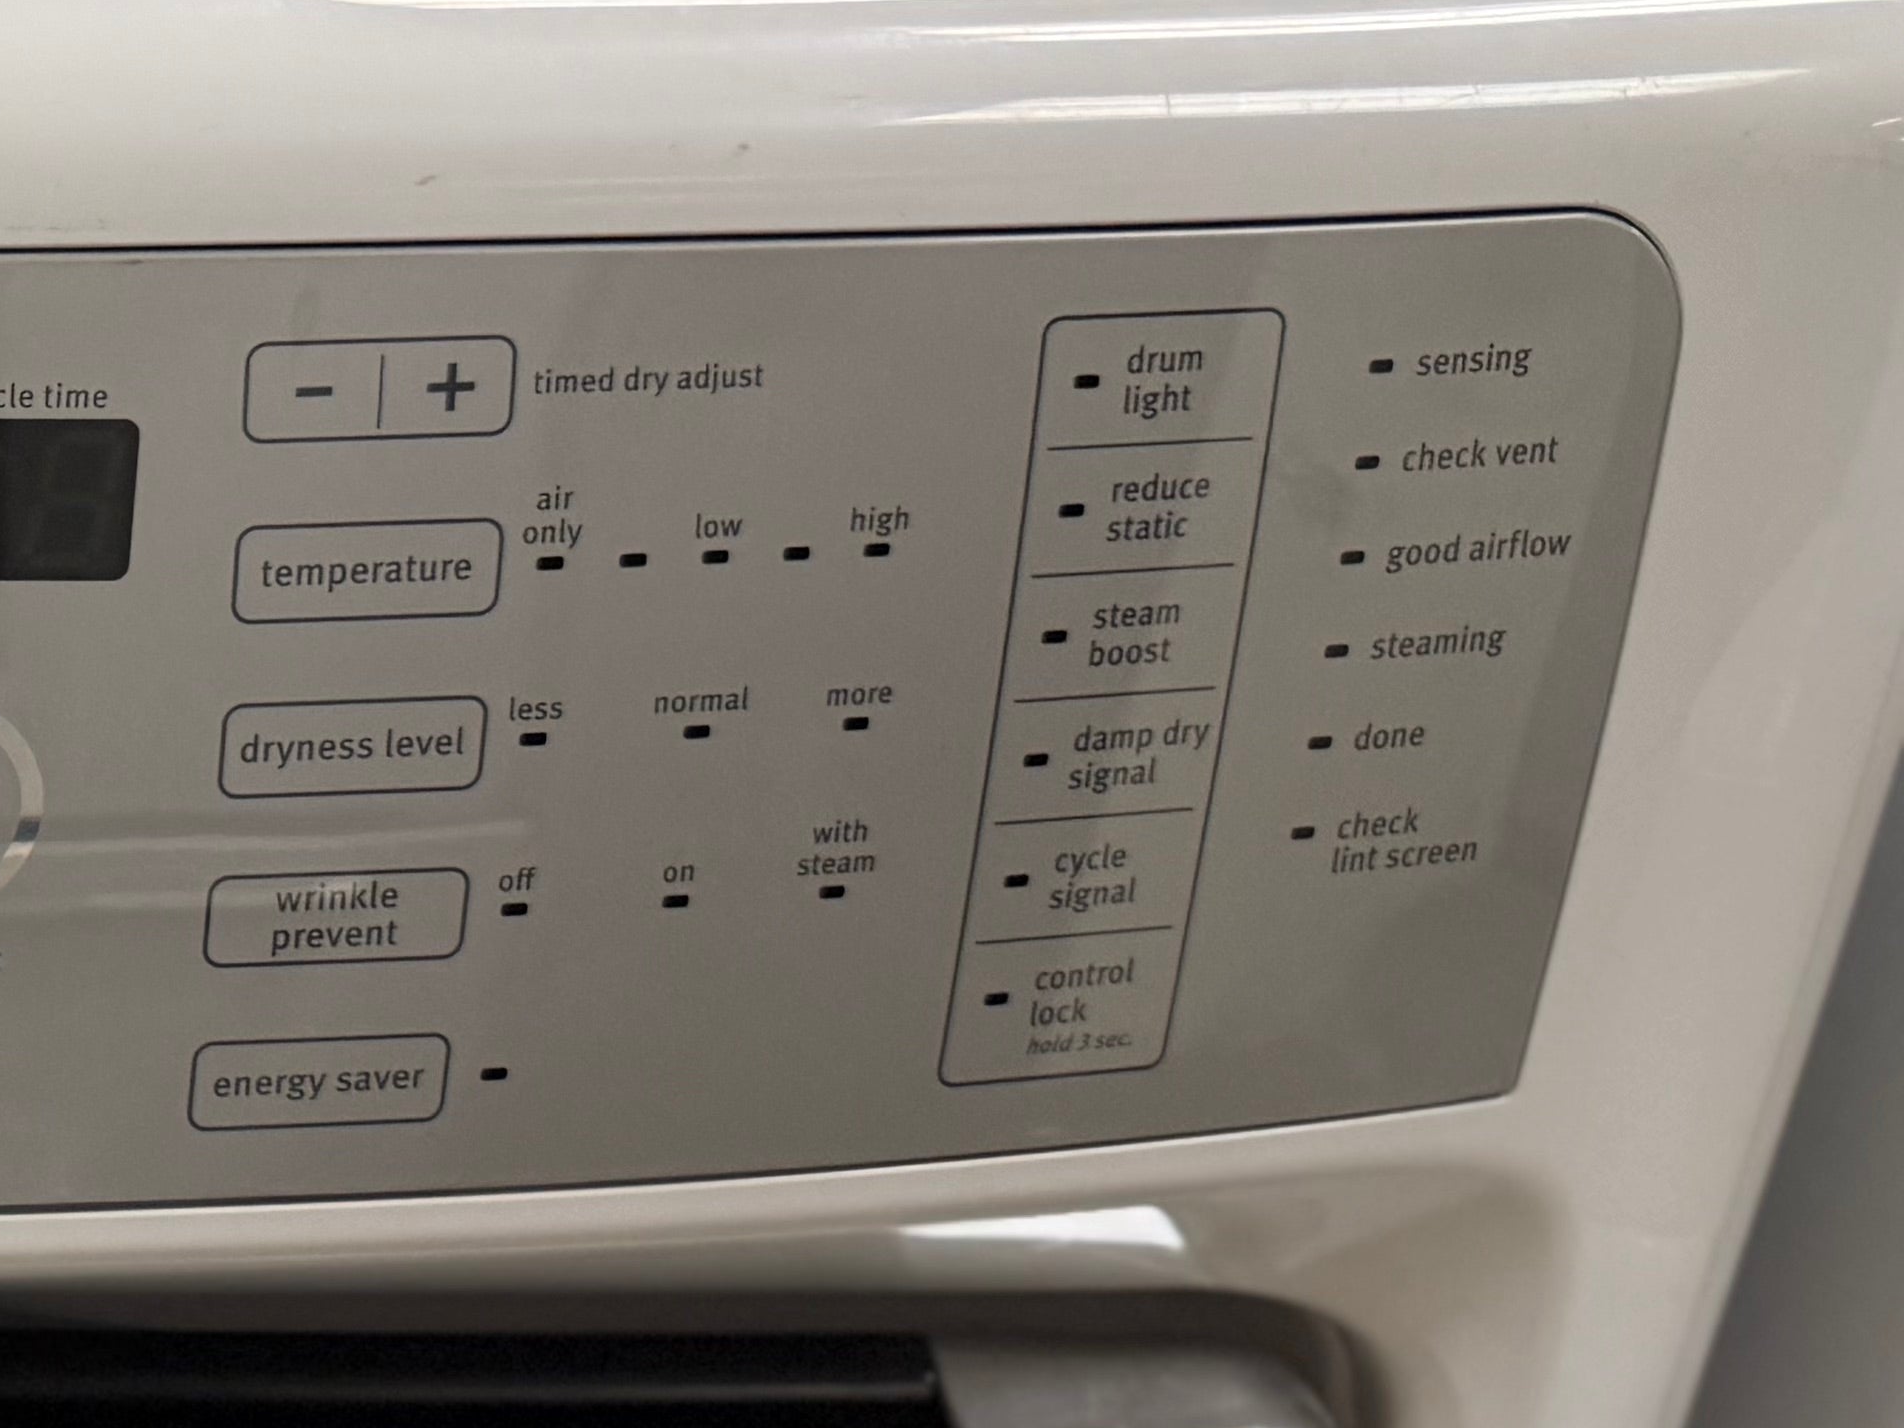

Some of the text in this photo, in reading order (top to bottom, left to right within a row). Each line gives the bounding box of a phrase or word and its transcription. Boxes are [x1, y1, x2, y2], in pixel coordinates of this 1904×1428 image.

[1128, 345, 1202, 374] drum
[1417, 343, 1532, 377] sensing
[45, 383, 107, 408] time
[535, 364, 763, 396] timed dry adjust
[1124, 383, 1191, 420] light
[1403, 437, 1558, 471] check vent
[536, 486, 574, 512] air
[1112, 473, 1209, 502] reduce
[523, 518, 582, 549] only
[696, 513, 742, 538] low
[851, 506, 909, 536] high
[1106, 511, 1187, 542] static
[1386, 530, 1571, 572] good airflow
[262, 556, 471, 592] temperature
[1093, 600, 1180, 629] steam
[1089, 639, 1170, 667] boost
[1371, 625, 1506, 659] steaming
[510, 697, 562, 721] less
[655, 686, 748, 713] normal
[826, 682, 893, 707] more
[241, 727, 463, 769] dryness level
[1073, 719, 1210, 755] damp dry
[1355, 723, 1424, 750] done
[1068, 758, 1155, 794] signal
[814, 820, 868, 843] with
[1338, 807, 1418, 839] check
[797, 849, 875, 877] steam
[1055, 844, 1127, 875] cycle
[1332, 837, 1478, 873] lint screen
[499, 867, 536, 892] off
[662, 861, 695, 884] on
[277, 881, 398, 912] wrinkle
[1048, 877, 1135, 913] signal
[272, 921, 397, 957] prevent
[1035, 958, 1134, 991] control
[1030, 998, 1086, 1027] lock
[1026, 1030, 1071, 1057] hold
[1077, 1033, 1091, 1051] 3
[212, 1064, 425, 1102] energy saver
